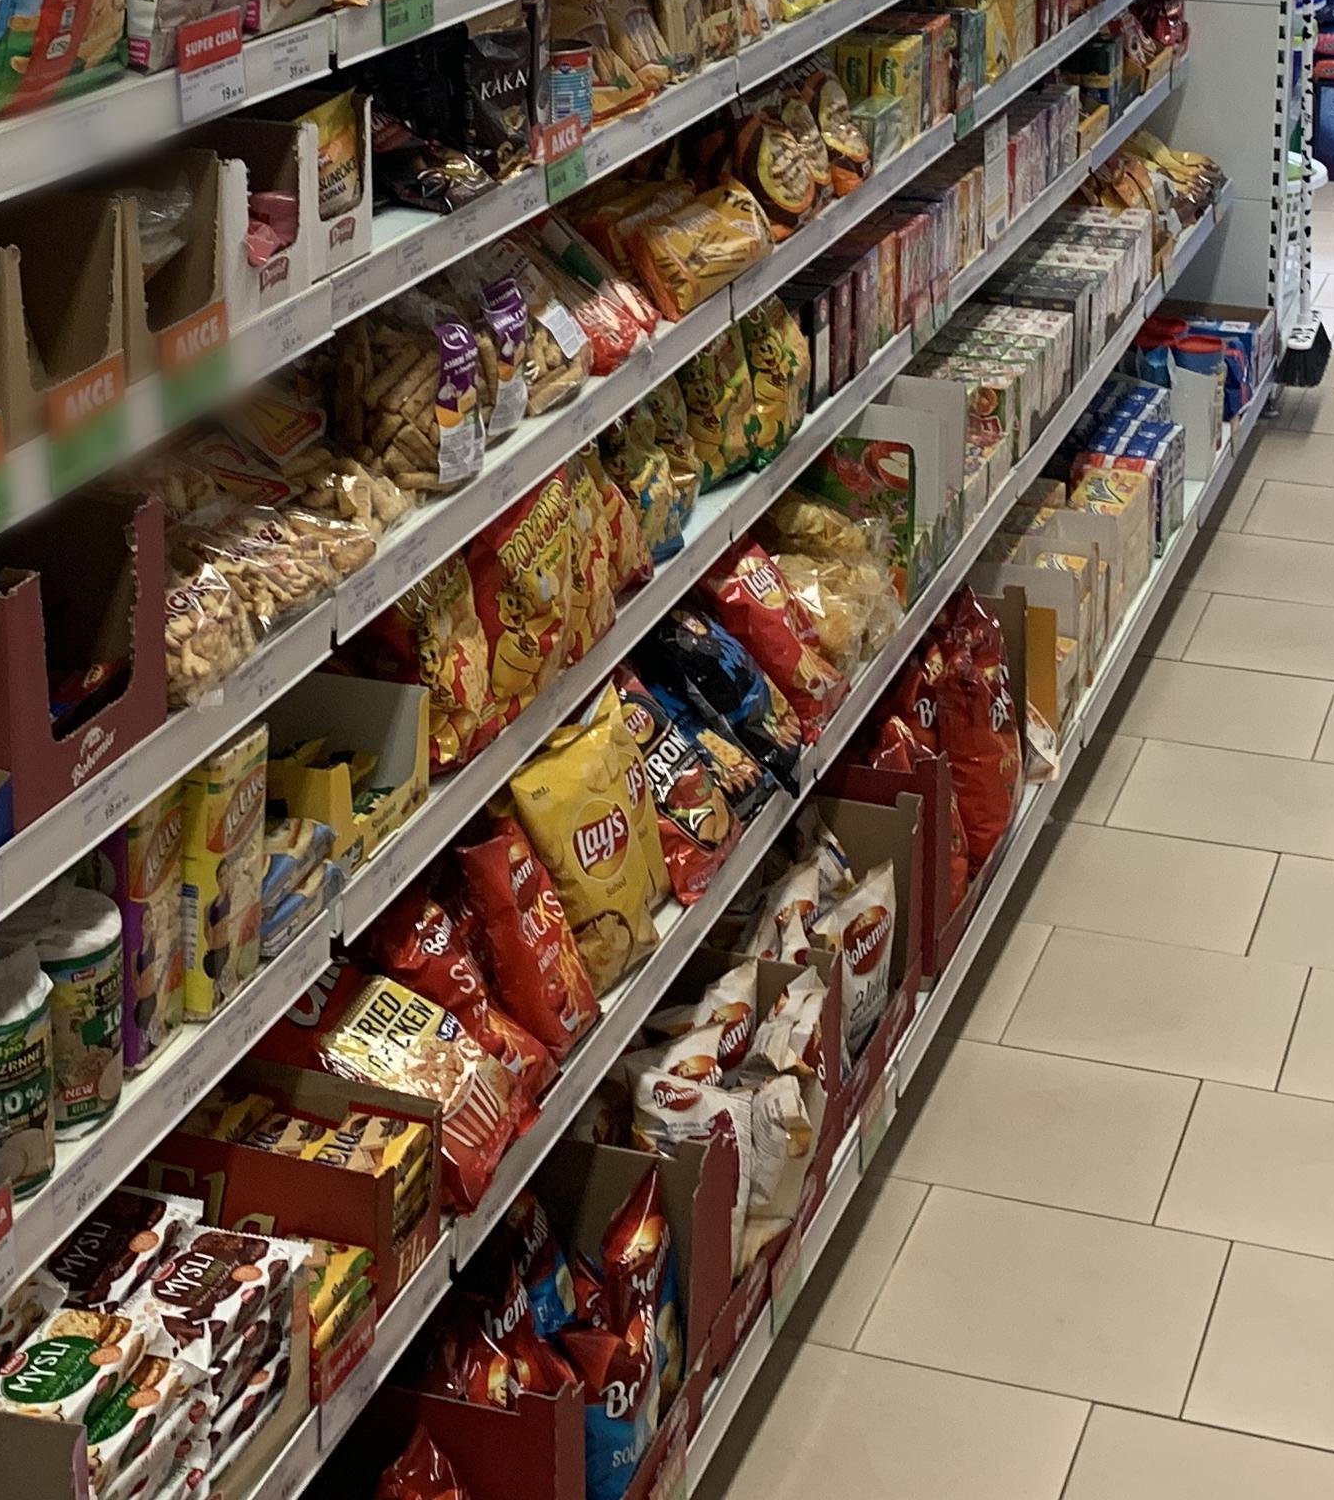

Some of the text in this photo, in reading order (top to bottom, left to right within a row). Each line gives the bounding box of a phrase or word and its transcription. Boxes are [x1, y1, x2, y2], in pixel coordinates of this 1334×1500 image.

[185, 27, 238, 58] SUPER CENA
[551, 128, 578, 154] AKCE
[175, 316, 221, 363] AKCE
[64, 373, 114, 417] AKCE
[575, 804, 627, 869] Lay's
[65, 1083, 95, 1098] NEW
[158, 1251, 216, 1303] MYSLI
[7, 1340, 72, 1396] MYSLI
